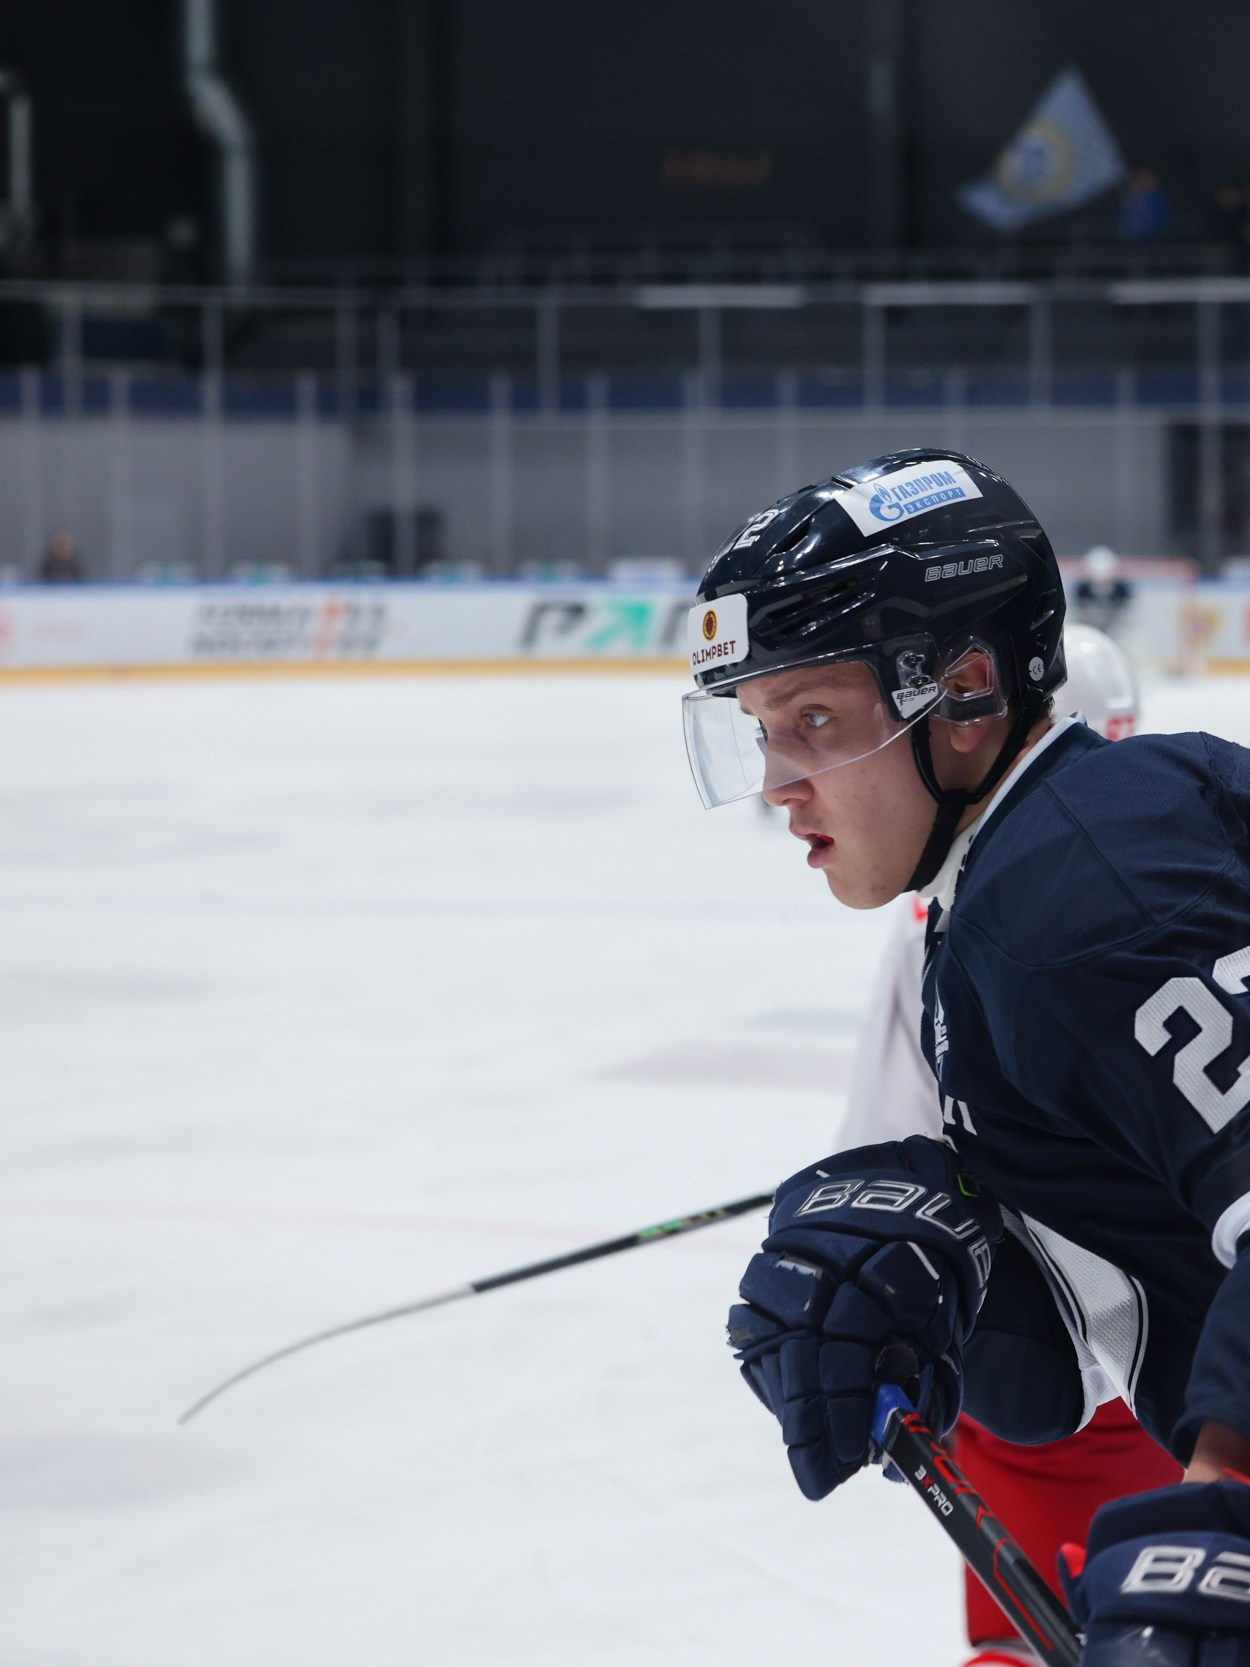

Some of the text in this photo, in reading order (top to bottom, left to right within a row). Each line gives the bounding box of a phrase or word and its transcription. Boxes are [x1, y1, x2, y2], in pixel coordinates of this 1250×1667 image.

[890, 470, 957, 501] ГАЗПРОМ
[908, 488, 965, 513] ЭКСПОРТ
[692, 640, 736, 666] OLIMPBET
